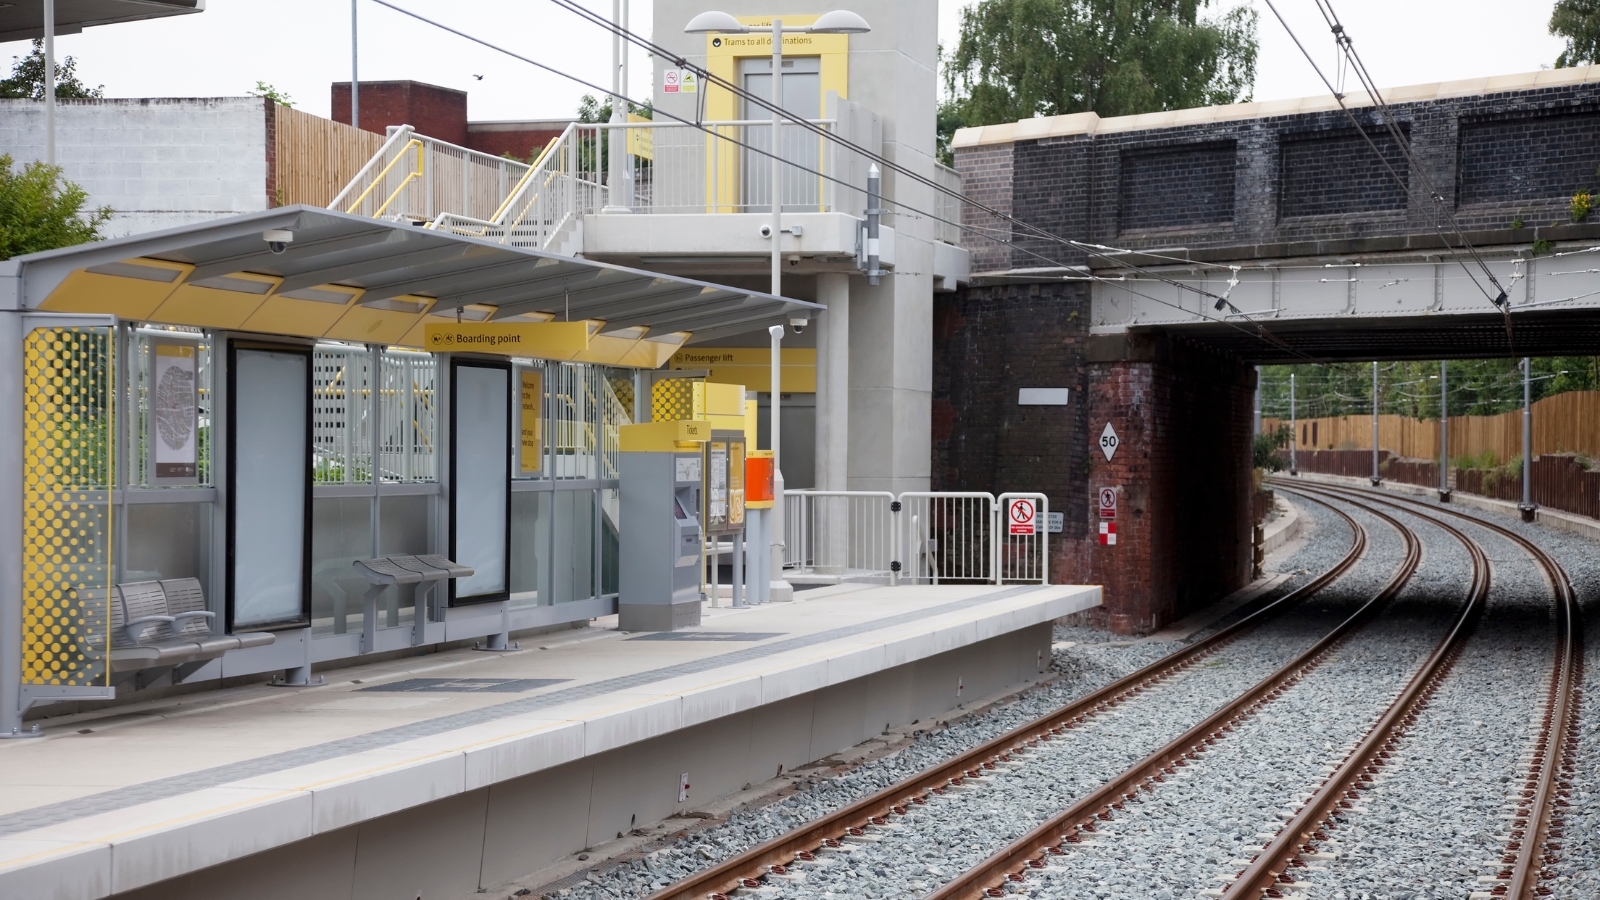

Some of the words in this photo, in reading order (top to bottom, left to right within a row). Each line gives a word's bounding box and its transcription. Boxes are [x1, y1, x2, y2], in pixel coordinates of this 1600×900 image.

[724, 37, 746, 46] Trams
[747, 37, 755, 46] to
[756, 36, 765, 46] all
[456, 334, 496, 345] Boarding
[497, 334, 521, 345] point
[685, 354, 722, 363] Passenger
[722, 354, 733, 362] lift
[686, 424, 698, 435] Tickets
[1102, 435, 1117, 448] 50
